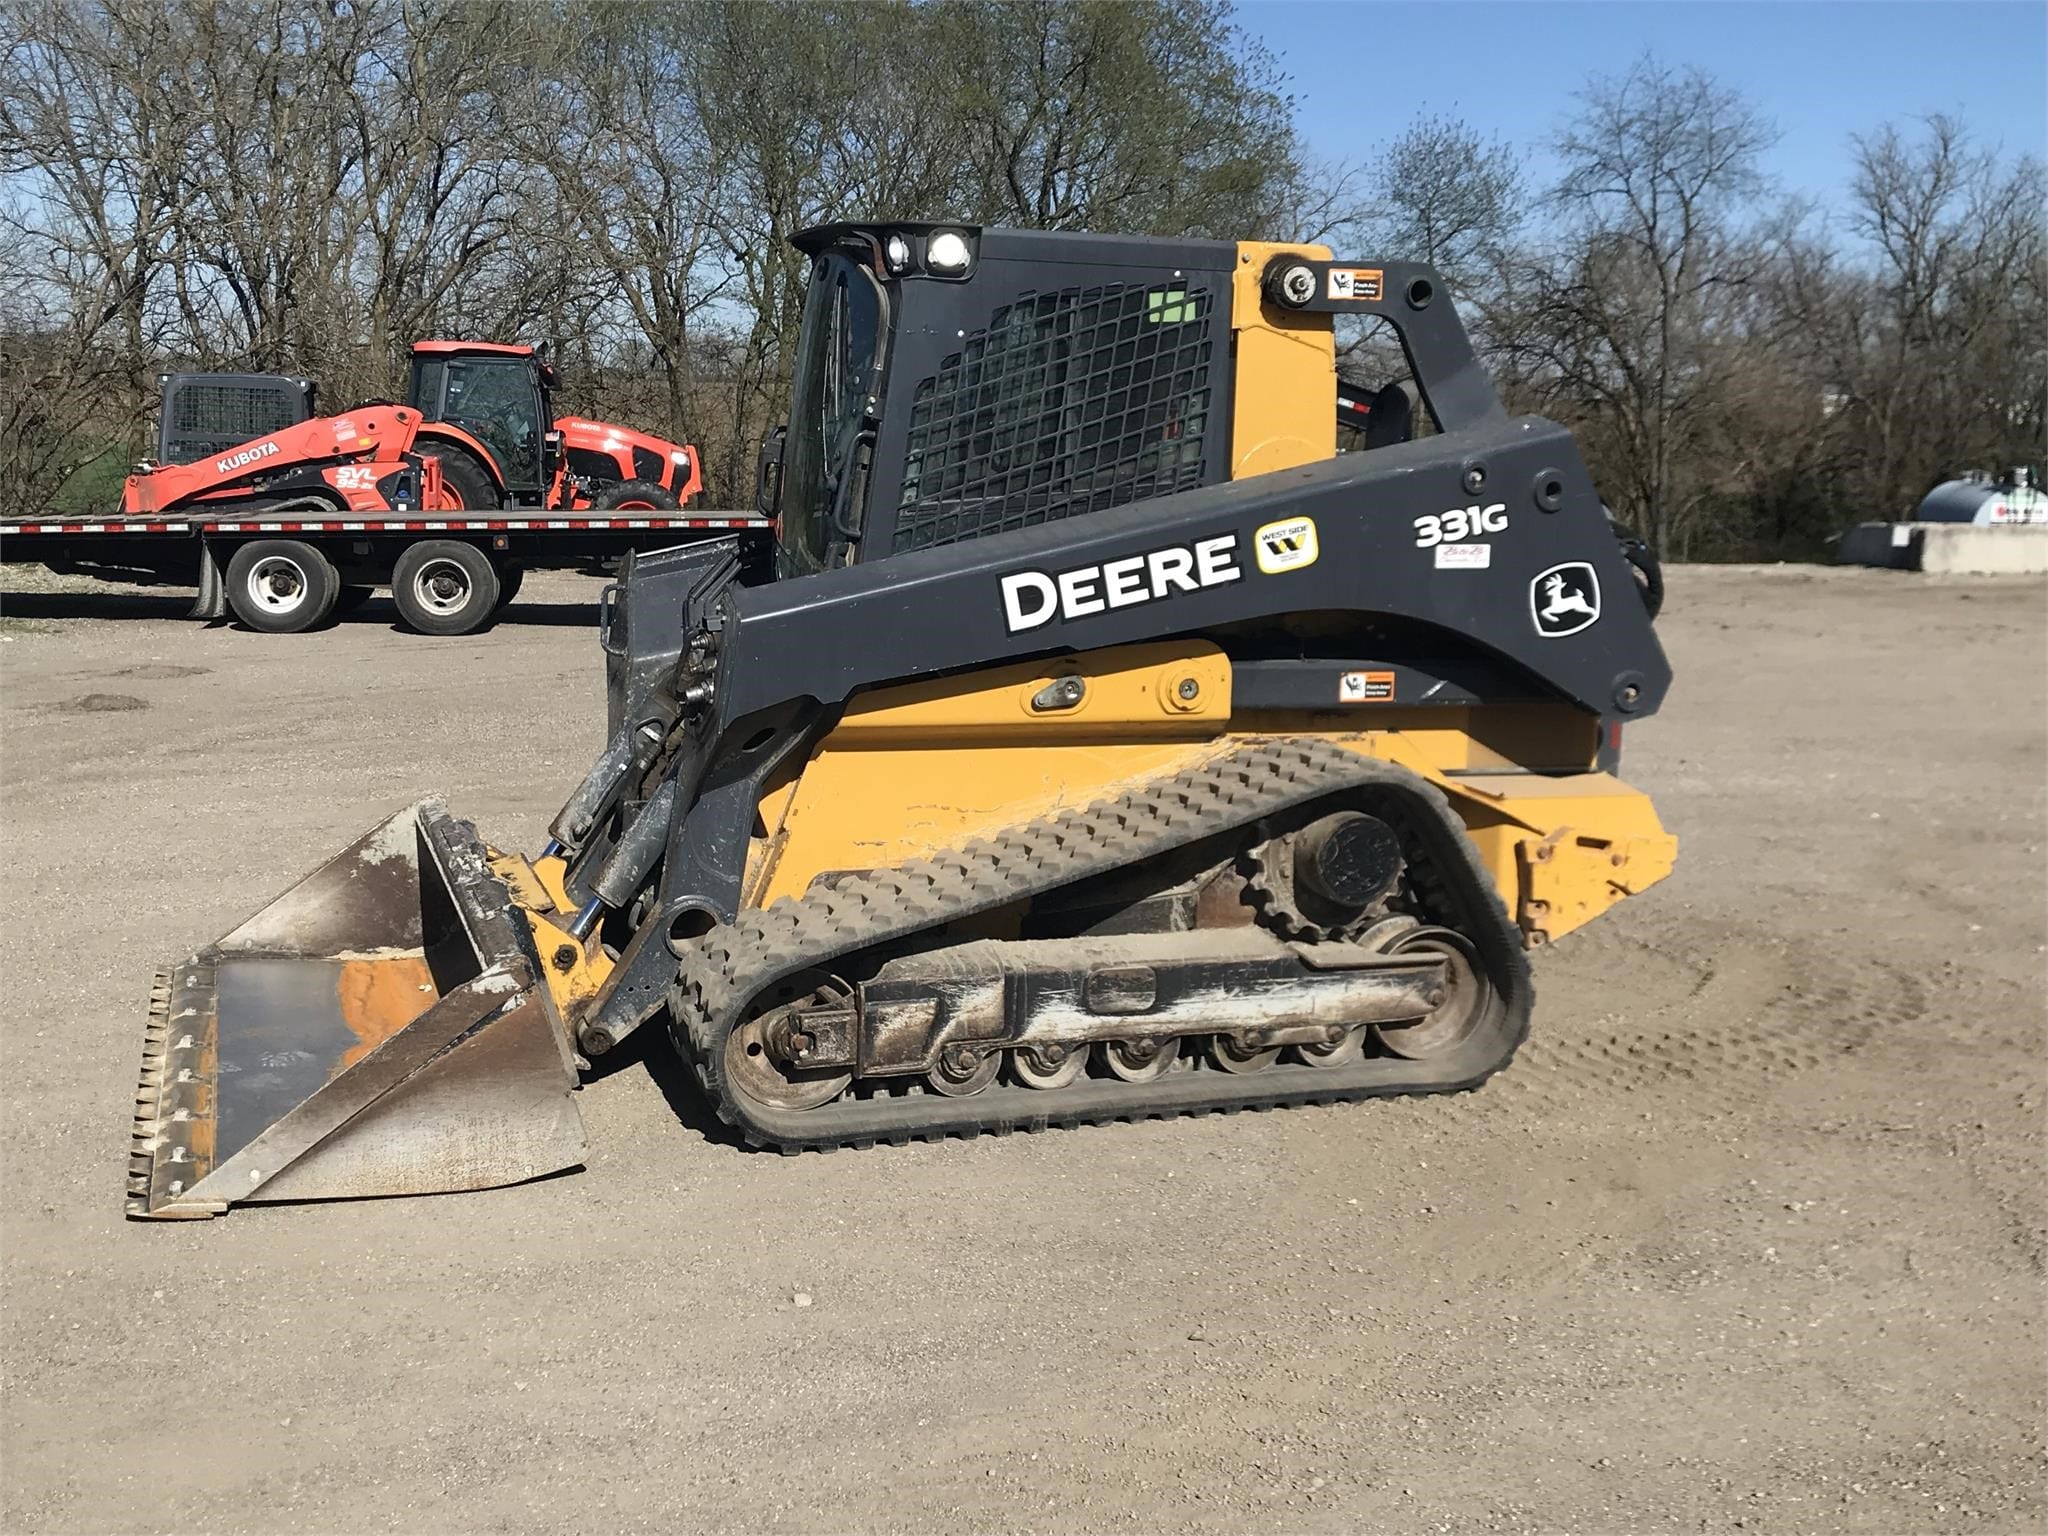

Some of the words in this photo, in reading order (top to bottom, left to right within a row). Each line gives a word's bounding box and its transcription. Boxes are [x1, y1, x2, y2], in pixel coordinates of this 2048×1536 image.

[571, 422, 601, 432] KUBOTA
[216, 441, 281, 474] KUBOTA
[336, 466, 378, 481] SVL
[1261, 530, 1287, 541] WEST
[1288, 524, 1309, 535] SIDE
[1413, 503, 1509, 548] 331G
[1000, 534, 1241, 633] DEERE
